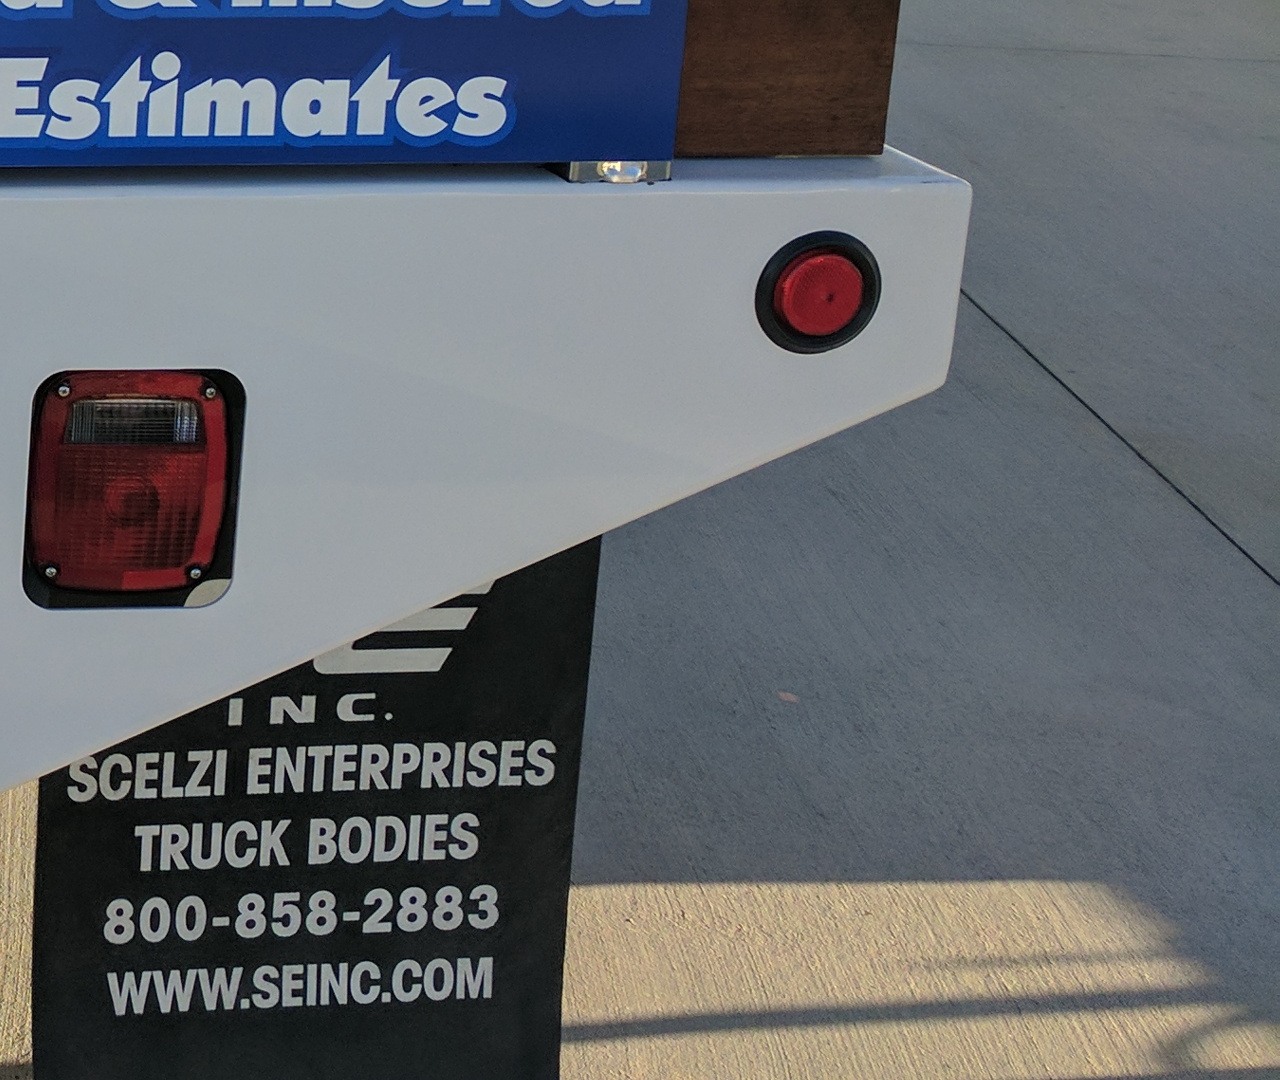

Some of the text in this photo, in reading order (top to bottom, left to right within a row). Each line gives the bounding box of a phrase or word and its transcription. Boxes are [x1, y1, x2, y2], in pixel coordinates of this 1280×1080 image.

[227, 692, 395, 727] INC.
[66, 739, 557, 803] SCELZI ENTERPRISES
[134, 812, 480, 873] TRUCK BODIES
[102, 884, 501, 946] 800-858-2883
[106, 956, 494, 1018] WWW.SEINC.COM
